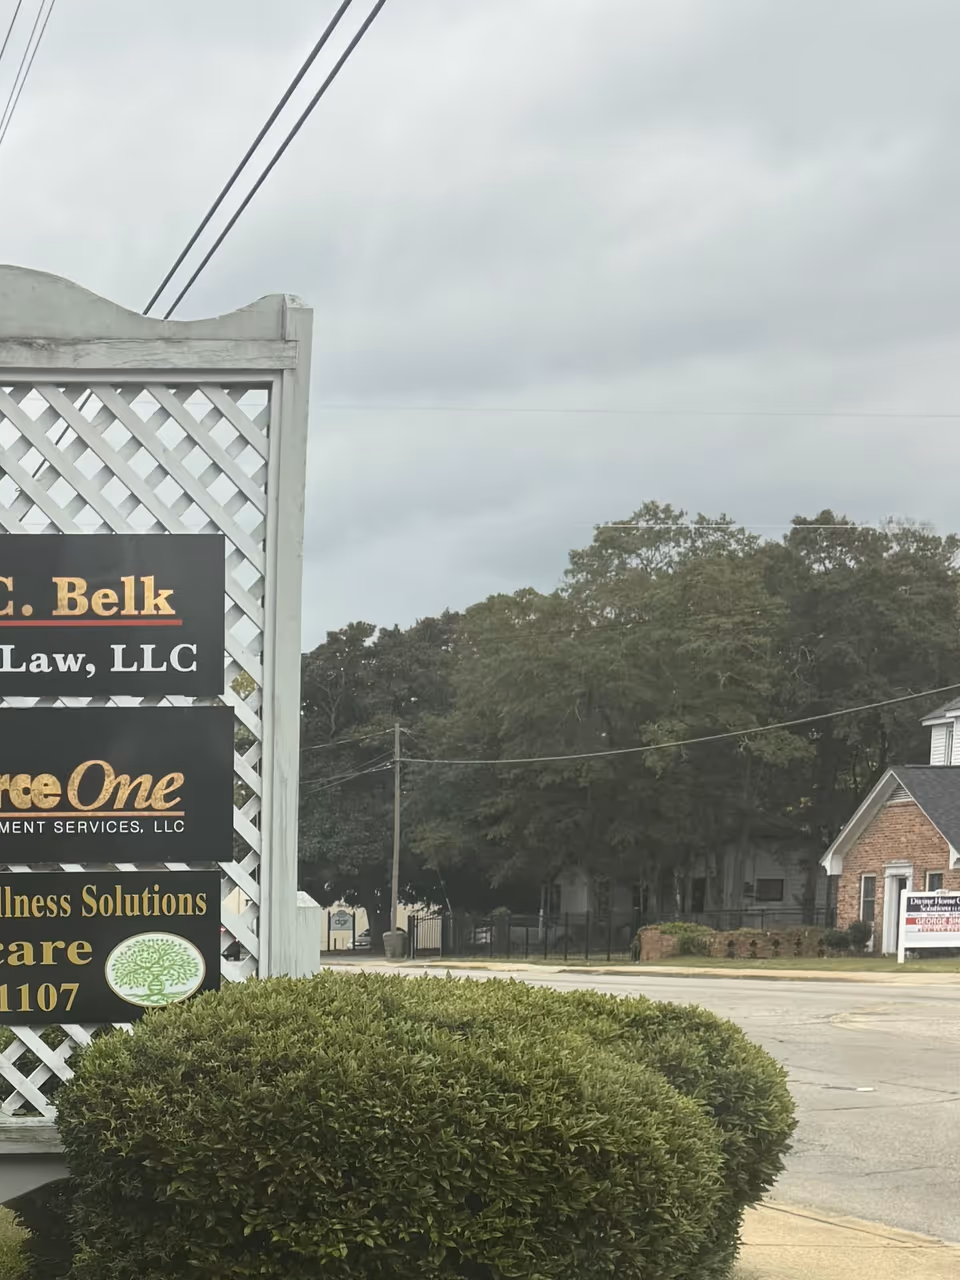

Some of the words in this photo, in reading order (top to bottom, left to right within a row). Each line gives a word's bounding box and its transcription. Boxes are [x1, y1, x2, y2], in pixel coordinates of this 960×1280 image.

[51, 574, 177, 617] Belk
[110, 643, 198, 673] LLC
[53, 820, 144, 834] SERVICES,
[154, 819, 185, 833] LLC
[81, 883, 207, 917] Solutions
